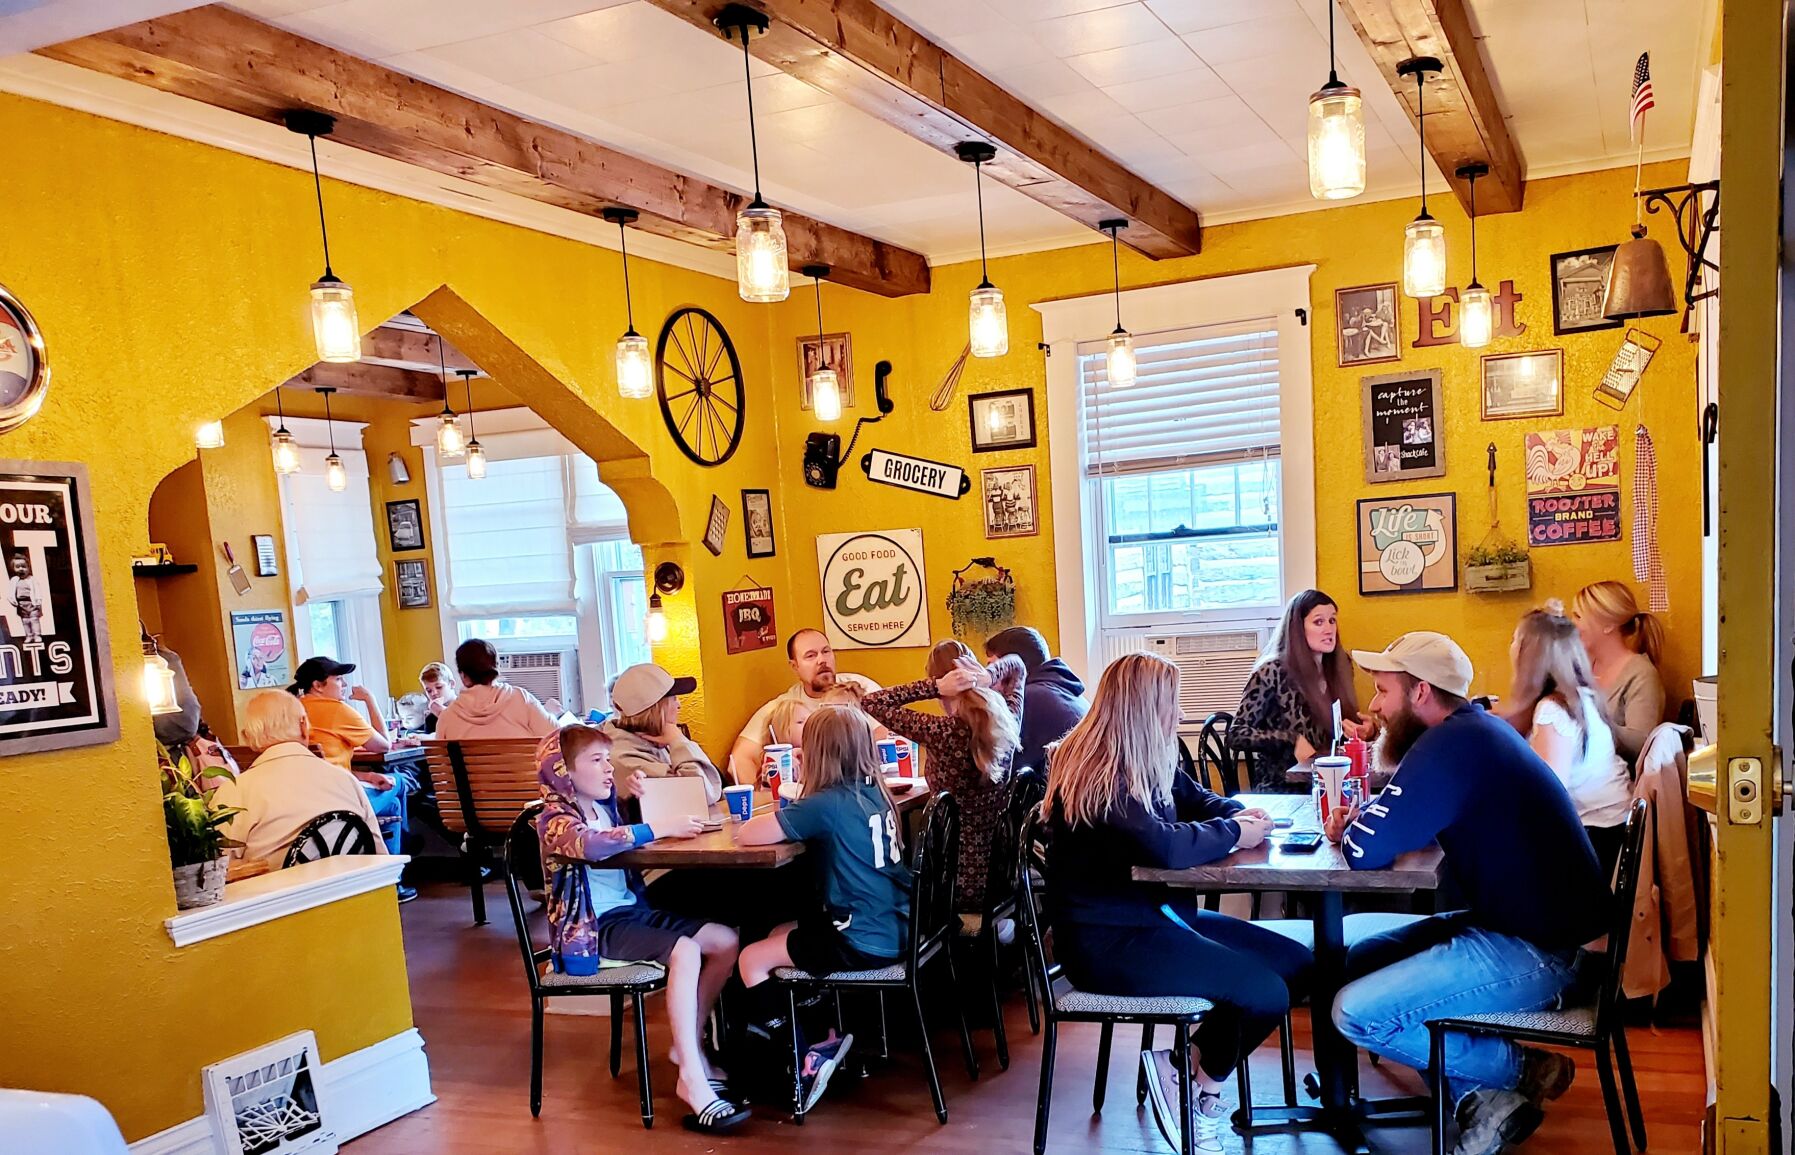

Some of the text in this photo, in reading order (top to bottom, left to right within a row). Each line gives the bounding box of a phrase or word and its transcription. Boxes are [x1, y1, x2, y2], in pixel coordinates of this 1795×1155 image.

[1412, 280, 1526, 348] Et
[1377, 387, 1426, 403] capture
[1397, 398, 1408, 406] the
[1376, 402, 1429, 416] moment
[1583, 430, 1614, 443] WAKE
[1585, 451, 1614, 462] HELL
[884, 458, 947, 490] GROCERY
[1586, 462, 1615, 478] UP!
[1532, 494, 1615, 513] ROOSTER
[1371, 504, 1418, 537] Life
[1555, 511, 1594, 521] BRAND
[1415, 532, 1435, 541] SHORT
[1533, 520, 1616, 540] COFFEE
[842, 549, 896, 562] GOOD FOOD
[1386, 547, 1410, 564] Lick
[835, 562, 911, 617] Eat
[847, 621, 905, 632] SERVED HERE
[741, 795, 749, 816] pepsi
